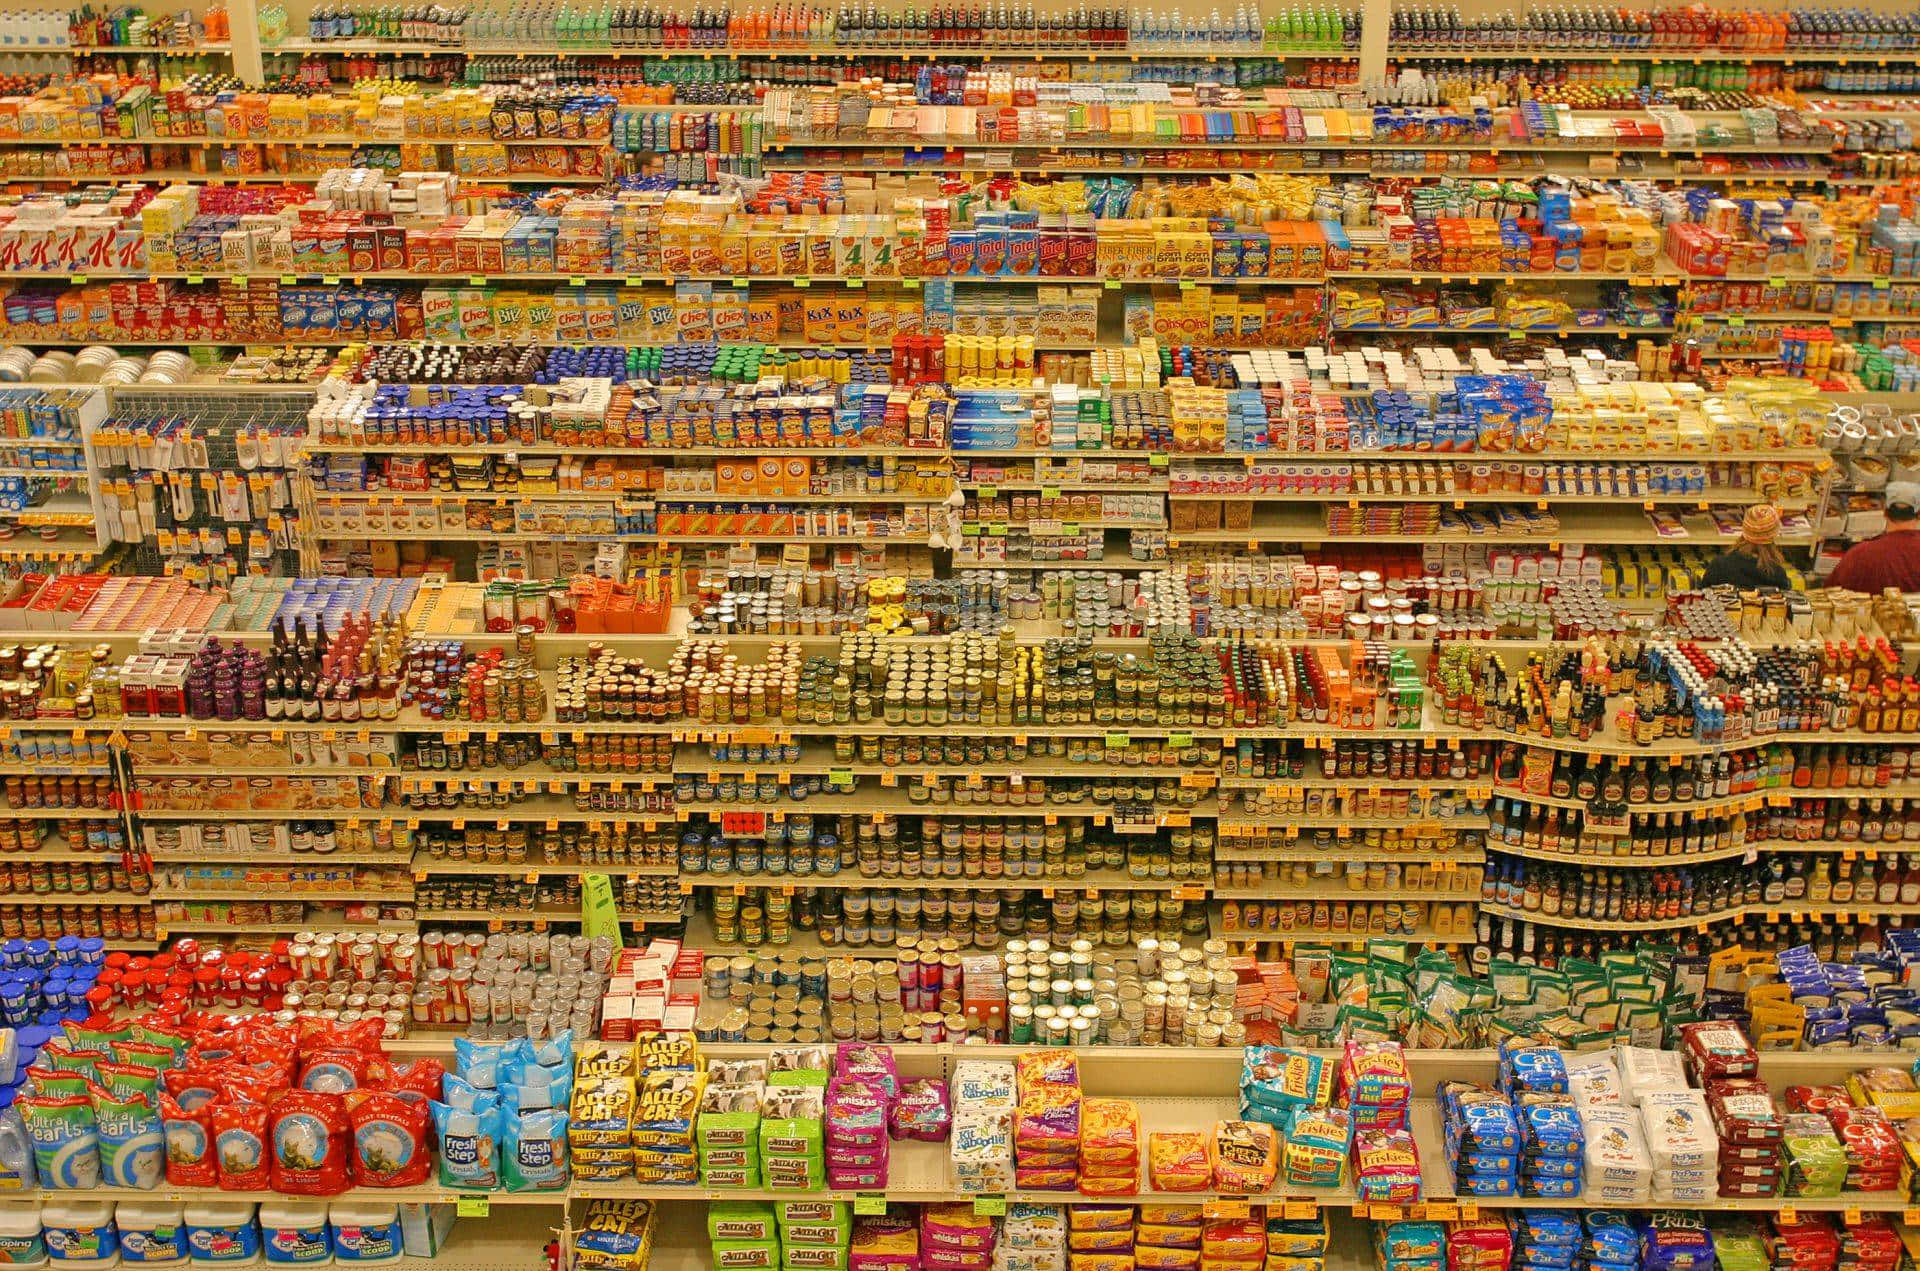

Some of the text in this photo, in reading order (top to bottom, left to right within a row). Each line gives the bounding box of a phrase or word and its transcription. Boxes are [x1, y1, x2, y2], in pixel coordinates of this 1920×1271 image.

[31, 236, 51, 265] K
[59, 229, 79, 260] K
[89, 227, 116, 267] K
[119, 235, 145, 267] K
[926, 242, 948, 254] Total
[949, 242, 975, 255] Total
[979, 241, 1005, 255] Total
[1010, 240, 1037, 254] Total
[1040, 240, 1066, 254] Total
[1069, 240, 1095, 254] Total
[1098, 245, 1125, 253] FIBER
[1126, 245, 1153, 253] FIBER
[4, 237, 23, 266] K
[663, 246, 684, 258] Chex
[692, 246, 713, 258] Chex
[724, 247, 742, 258] Chex
[846, 244, 862, 263] 4
[874, 244, 892, 263] 4
[426, 300, 452, 312] Chex
[462, 308, 489, 321] Chex
[559, 312, 585, 325] Chex
[590, 312, 616, 325] Chex
[681, 312, 708, 325] Chex
[716, 311, 744, 325] Chex
[751, 311, 772, 322] KIX
[807, 306, 832, 320] KIX
[838, 306, 863, 320] KIX
[642, 1041, 689, 1055] ALLEY
[646, 1055, 680, 1066] CAT
[1358, 1054, 1401, 1072] Friskies
[1514, 1053, 1557, 1066] Cat
[581, 1062, 629, 1077] ALLEY
[847, 1065, 888, 1074] whiskas
[1289, 1056, 1304, 1095] Friskies
[964, 1082, 980, 1090] Kit
[577, 1093, 629, 1107] ALLEY
[641, 1093, 693, 1107] ALLEY
[963, 1088, 1010, 1099] Kaboodle
[836, 1096, 879, 1106] whiskas
[901, 1095, 941, 1106] whiskas
[580, 1106, 616, 1120] CAT
[643, 1106, 677, 1120] CAT
[1466, 1108, 1510, 1119] Cat
[1530, 1108, 1569, 1121] Cat
[33, 1116, 64, 1129] Ultra
[959, 1129, 975, 1139] Kit
[1295, 1121, 1345, 1138] Friskies
[1843, 1124, 1891, 1139] Cat
[446, 1137, 477, 1149] Fresh
[520, 1140, 550, 1152] Fresh
[957, 1136, 1006, 1149] Kaboodle
[1789, 1139, 1828, 1151] Cat
[446, 1148, 476, 1163] Step
[520, 1152, 550, 1167] Step
[1363, 1152, 1412, 1166] Friskies
[591, 1215, 633, 1233] CAT
[1650, 1213, 1706, 1230] PRIDE
[0, 1239, 32, 1250] oping
[932, 1233, 961, 1243] whiskas
[1535, 1232, 1559, 1244] Cat
[1596, 1248, 1620, 1260] Cat
[1792, 1252, 1816, 1262] Cat
[1859, 1248, 1882, 1258] Cat
